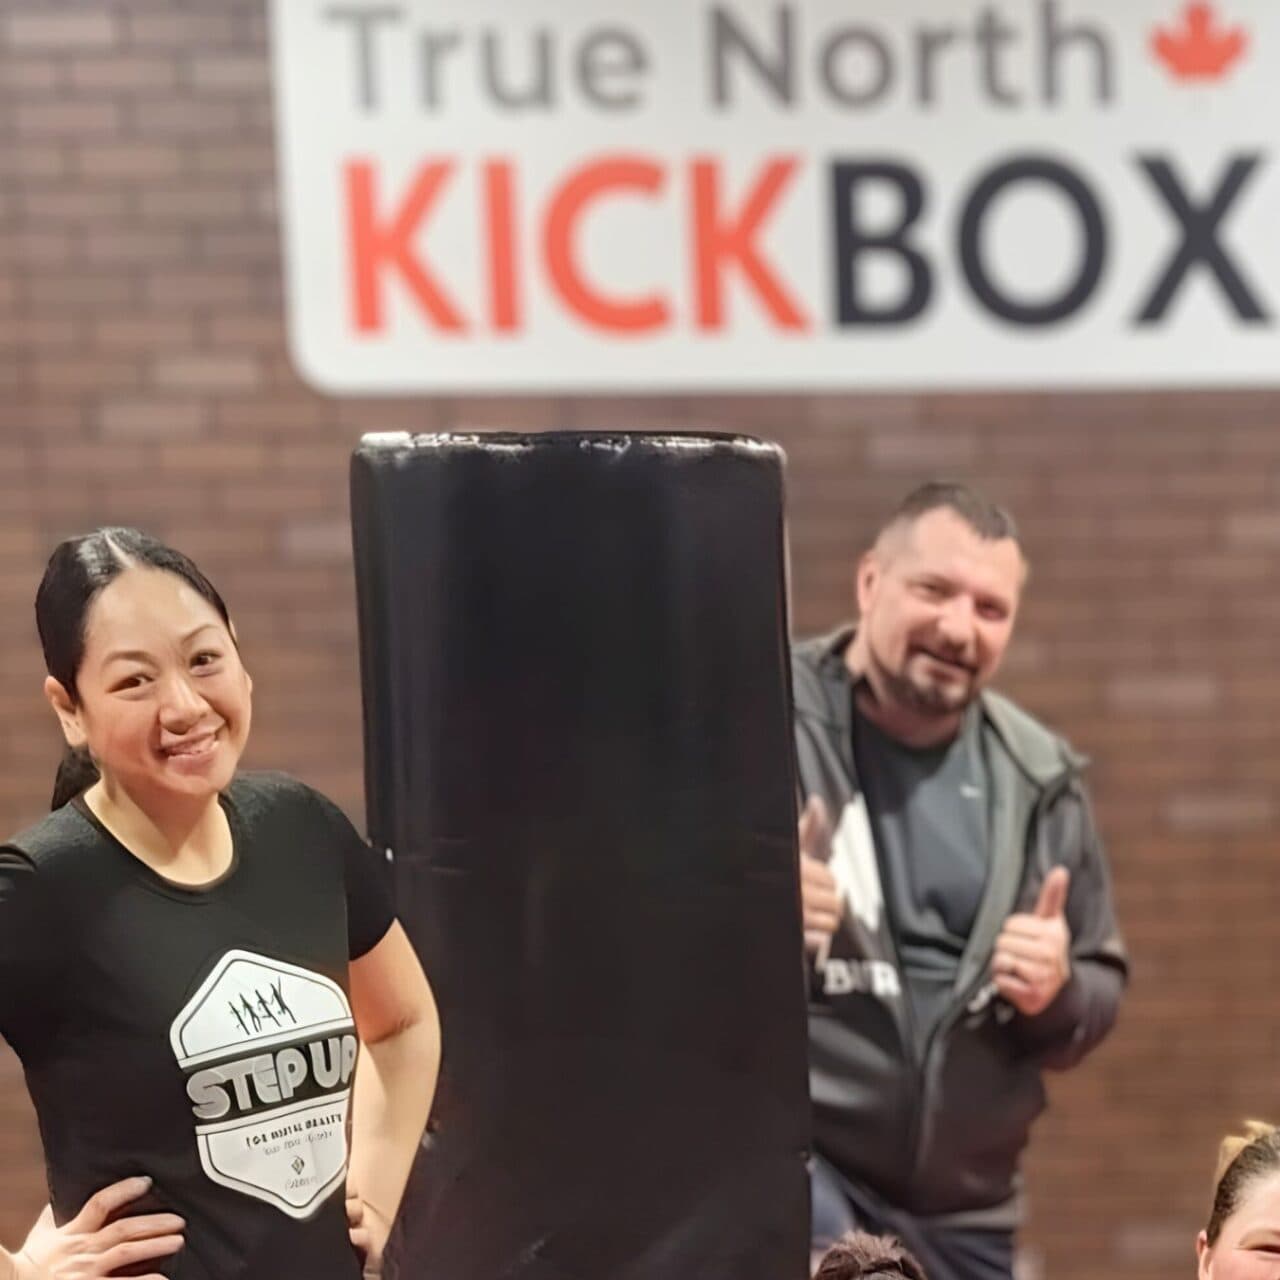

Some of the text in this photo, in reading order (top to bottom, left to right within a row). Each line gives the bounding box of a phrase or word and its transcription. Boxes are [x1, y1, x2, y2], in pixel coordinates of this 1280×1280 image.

[322, 0, 1117, 112] True North
[186, 1035, 357, 1120] STEP UP
